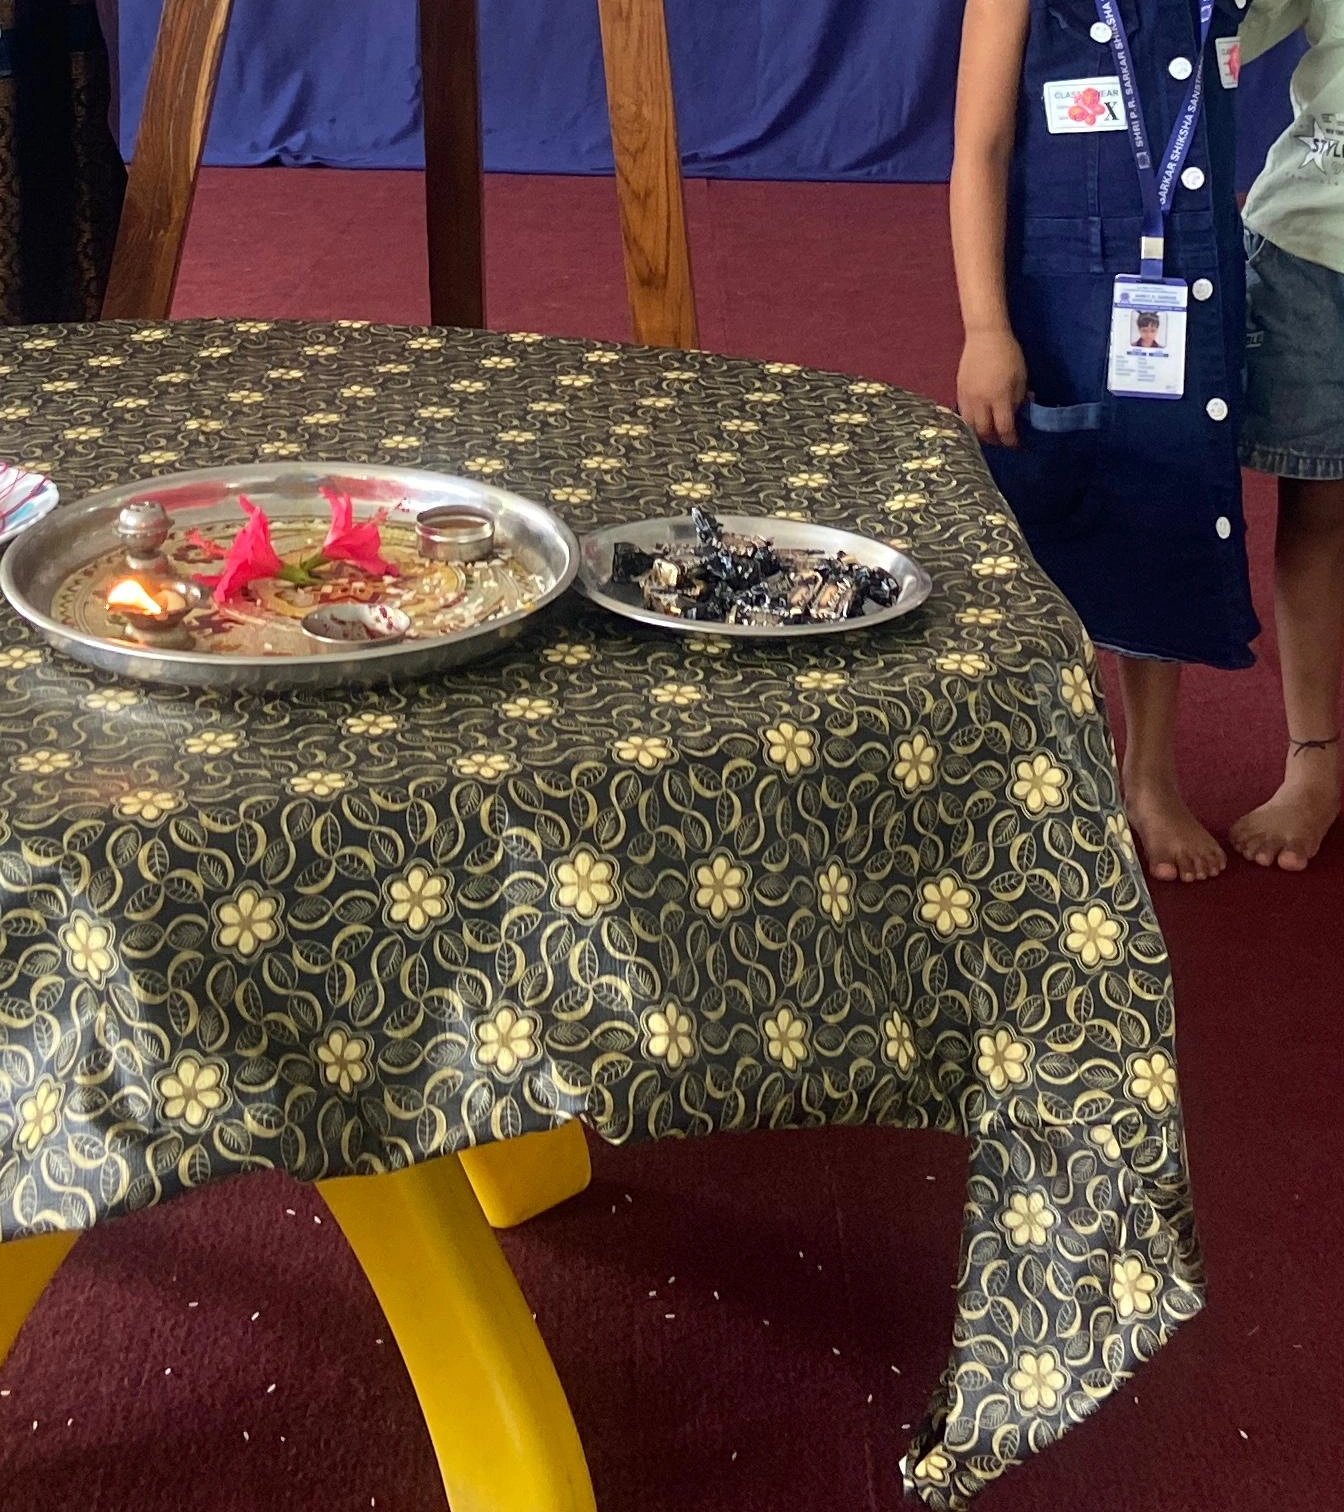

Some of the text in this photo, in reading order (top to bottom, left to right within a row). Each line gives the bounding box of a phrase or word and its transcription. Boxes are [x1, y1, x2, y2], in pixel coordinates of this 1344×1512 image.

[1115, 49, 1134, 96] SARKAR
[1103, 101, 1120, 121] X
[1129, 118, 1144, 148] SHRI
[1170, 113, 1194, 163] SHIKSHA
